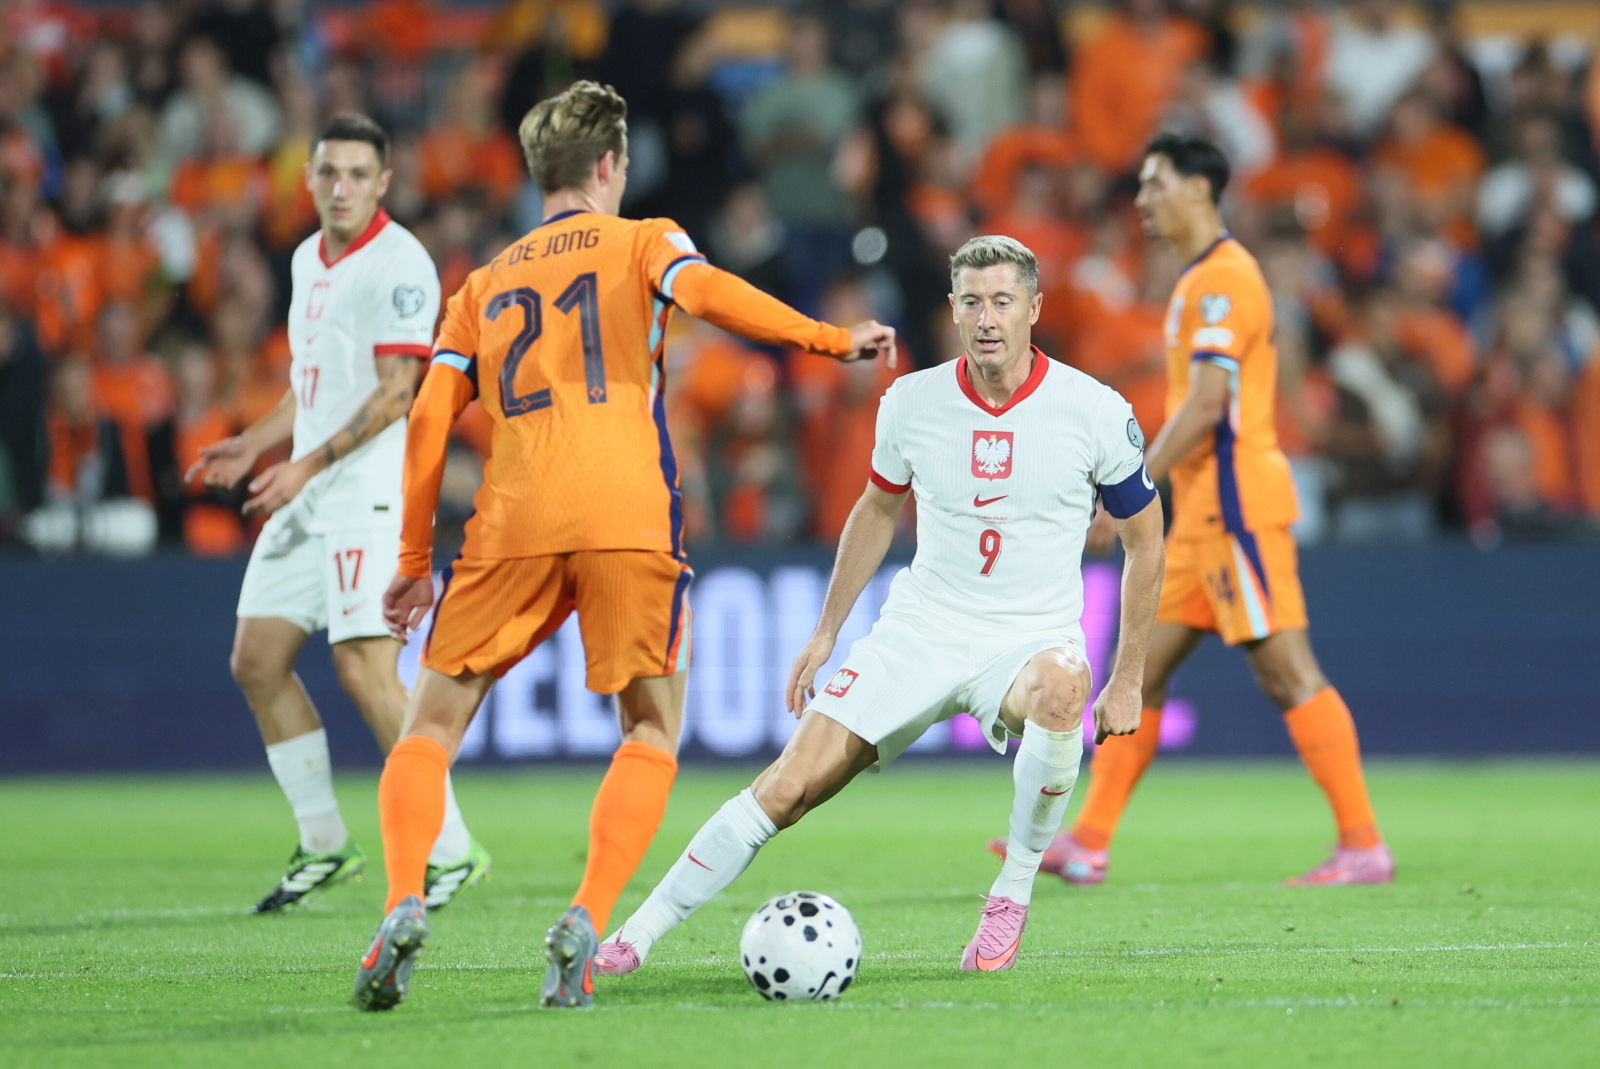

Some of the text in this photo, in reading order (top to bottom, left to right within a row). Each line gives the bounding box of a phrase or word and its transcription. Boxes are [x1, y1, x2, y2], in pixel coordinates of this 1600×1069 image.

[508, 240, 538, 266] DE
[541, 228, 600, 258] JONG
[484, 271, 607, 418] 21
[302, 367, 319, 408] 17
[334, 548, 364, 593] 17
[979, 528, 1003, 577] 9
